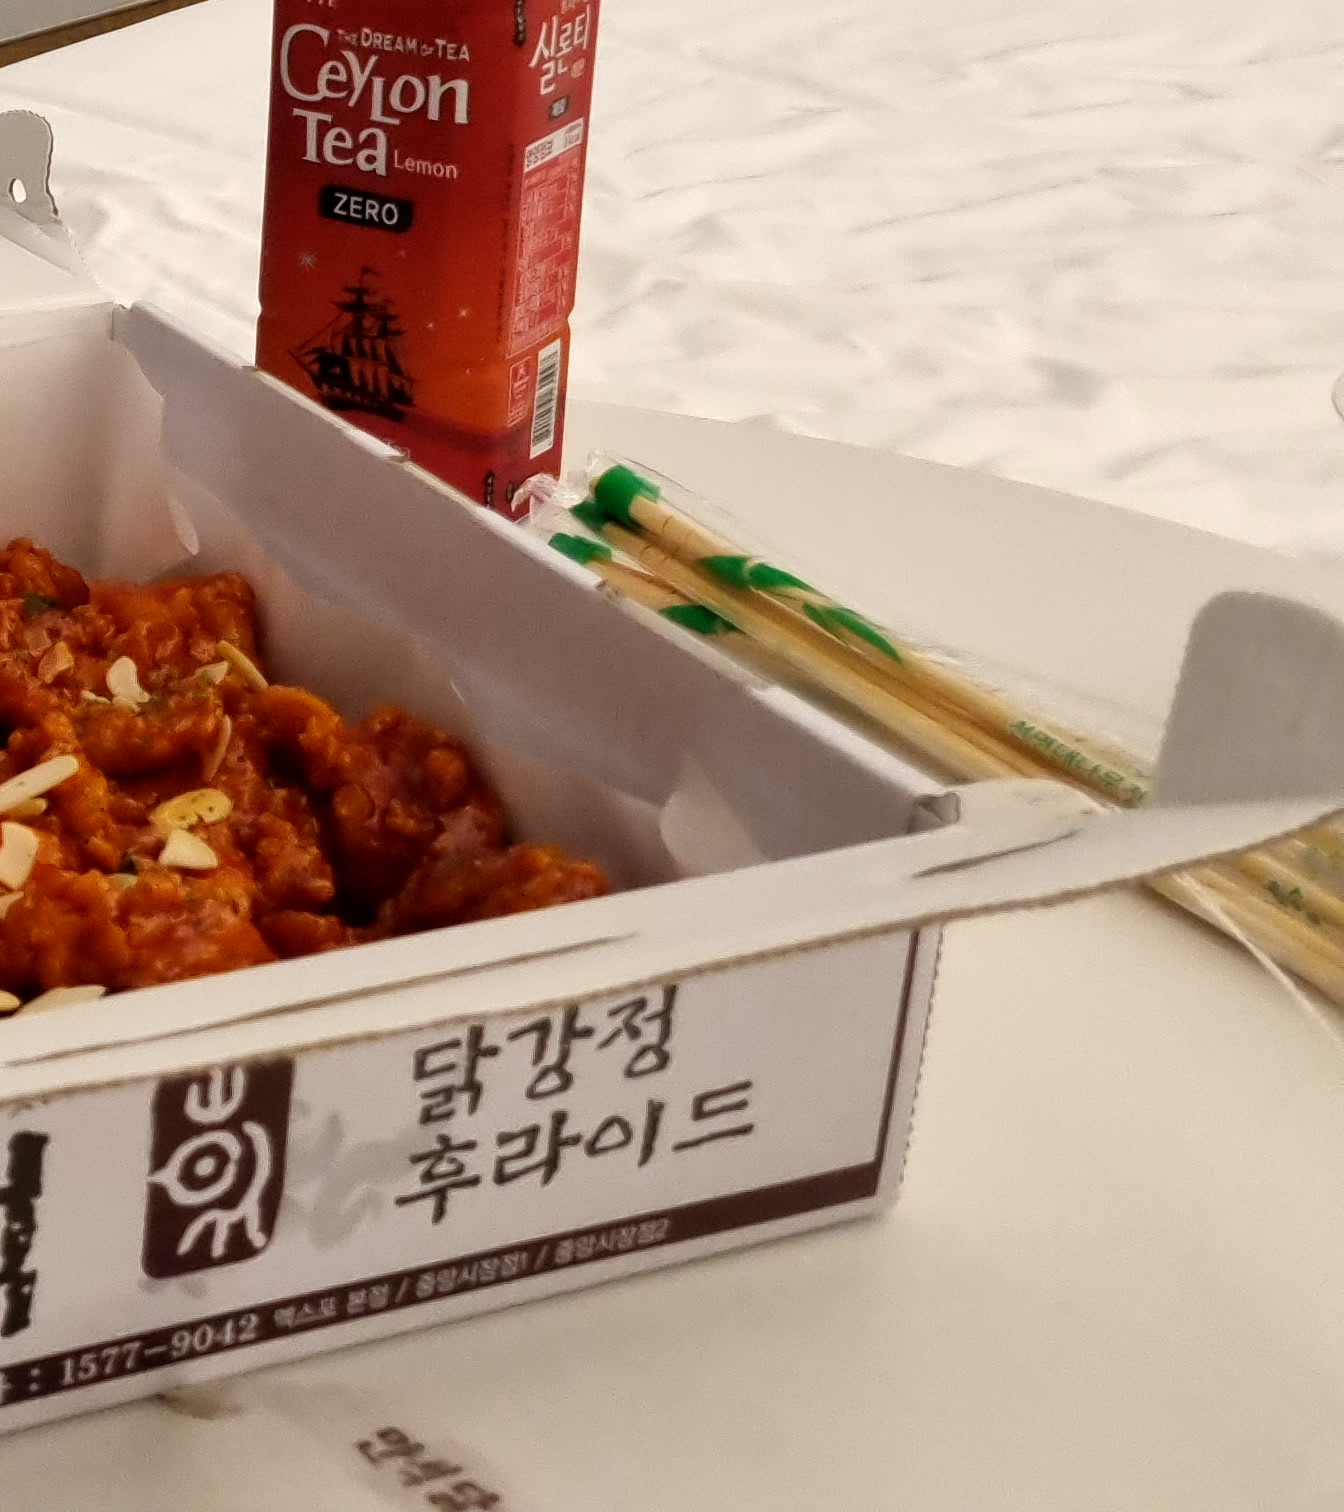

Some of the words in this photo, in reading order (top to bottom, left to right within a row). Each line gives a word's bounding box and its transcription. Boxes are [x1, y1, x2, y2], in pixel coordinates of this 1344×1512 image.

[434, 38, 471, 62] TEA
[519, 4, 592, 95] 실론티
[292, 106, 388, 177] Tea
[393, 149, 459, 180] Lemon
[332, 192, 400, 226] ZERO
[413, 985, 678, 1126] 닭강정
[395, 1079, 755, 1222] 후라이드
[61, 1314, 260, 1386] 1577-9042
